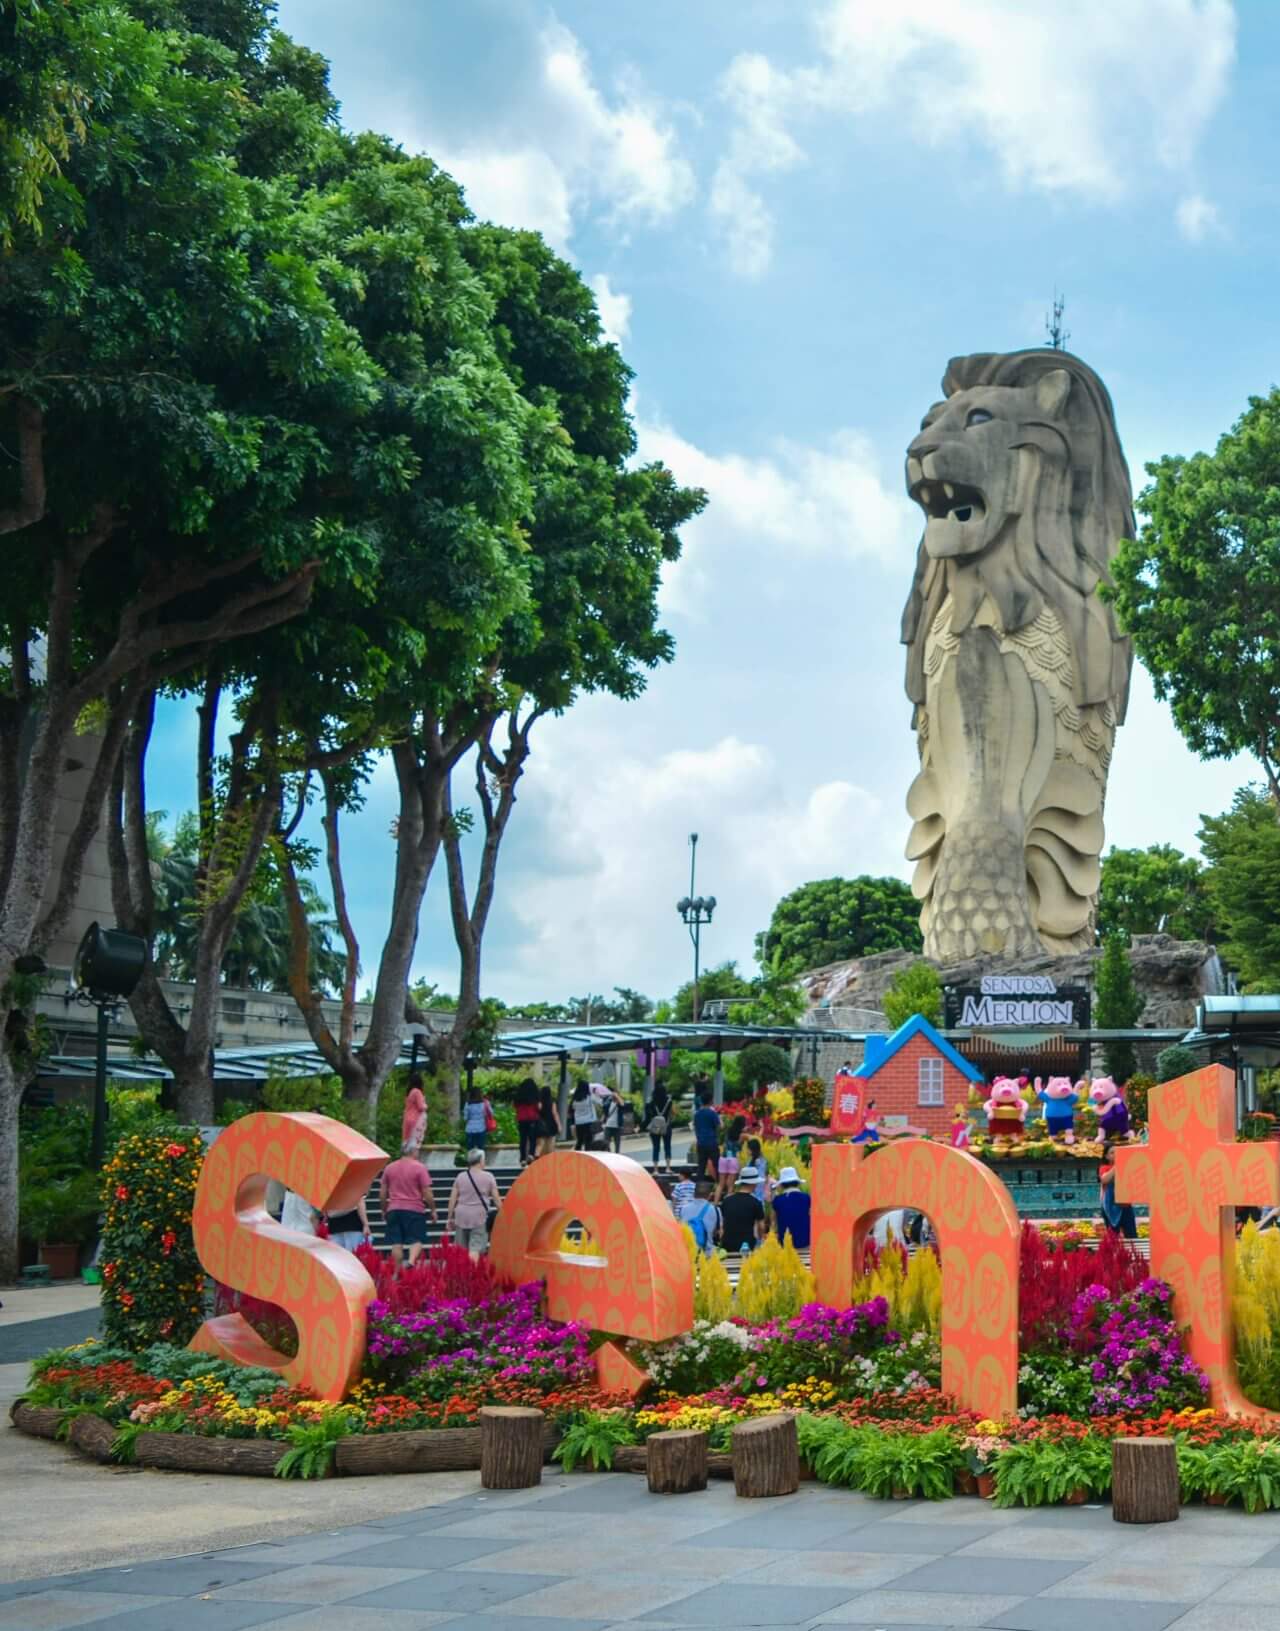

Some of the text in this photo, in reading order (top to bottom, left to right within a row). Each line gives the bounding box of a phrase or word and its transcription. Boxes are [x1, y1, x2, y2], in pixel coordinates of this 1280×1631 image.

[982, 977, 1055, 993] SENTOSA
[963, 997, 1071, 1024] MERLION
[840, 1093, 858, 1114] 春
[1162, 1162, 1191, 1217] 福
